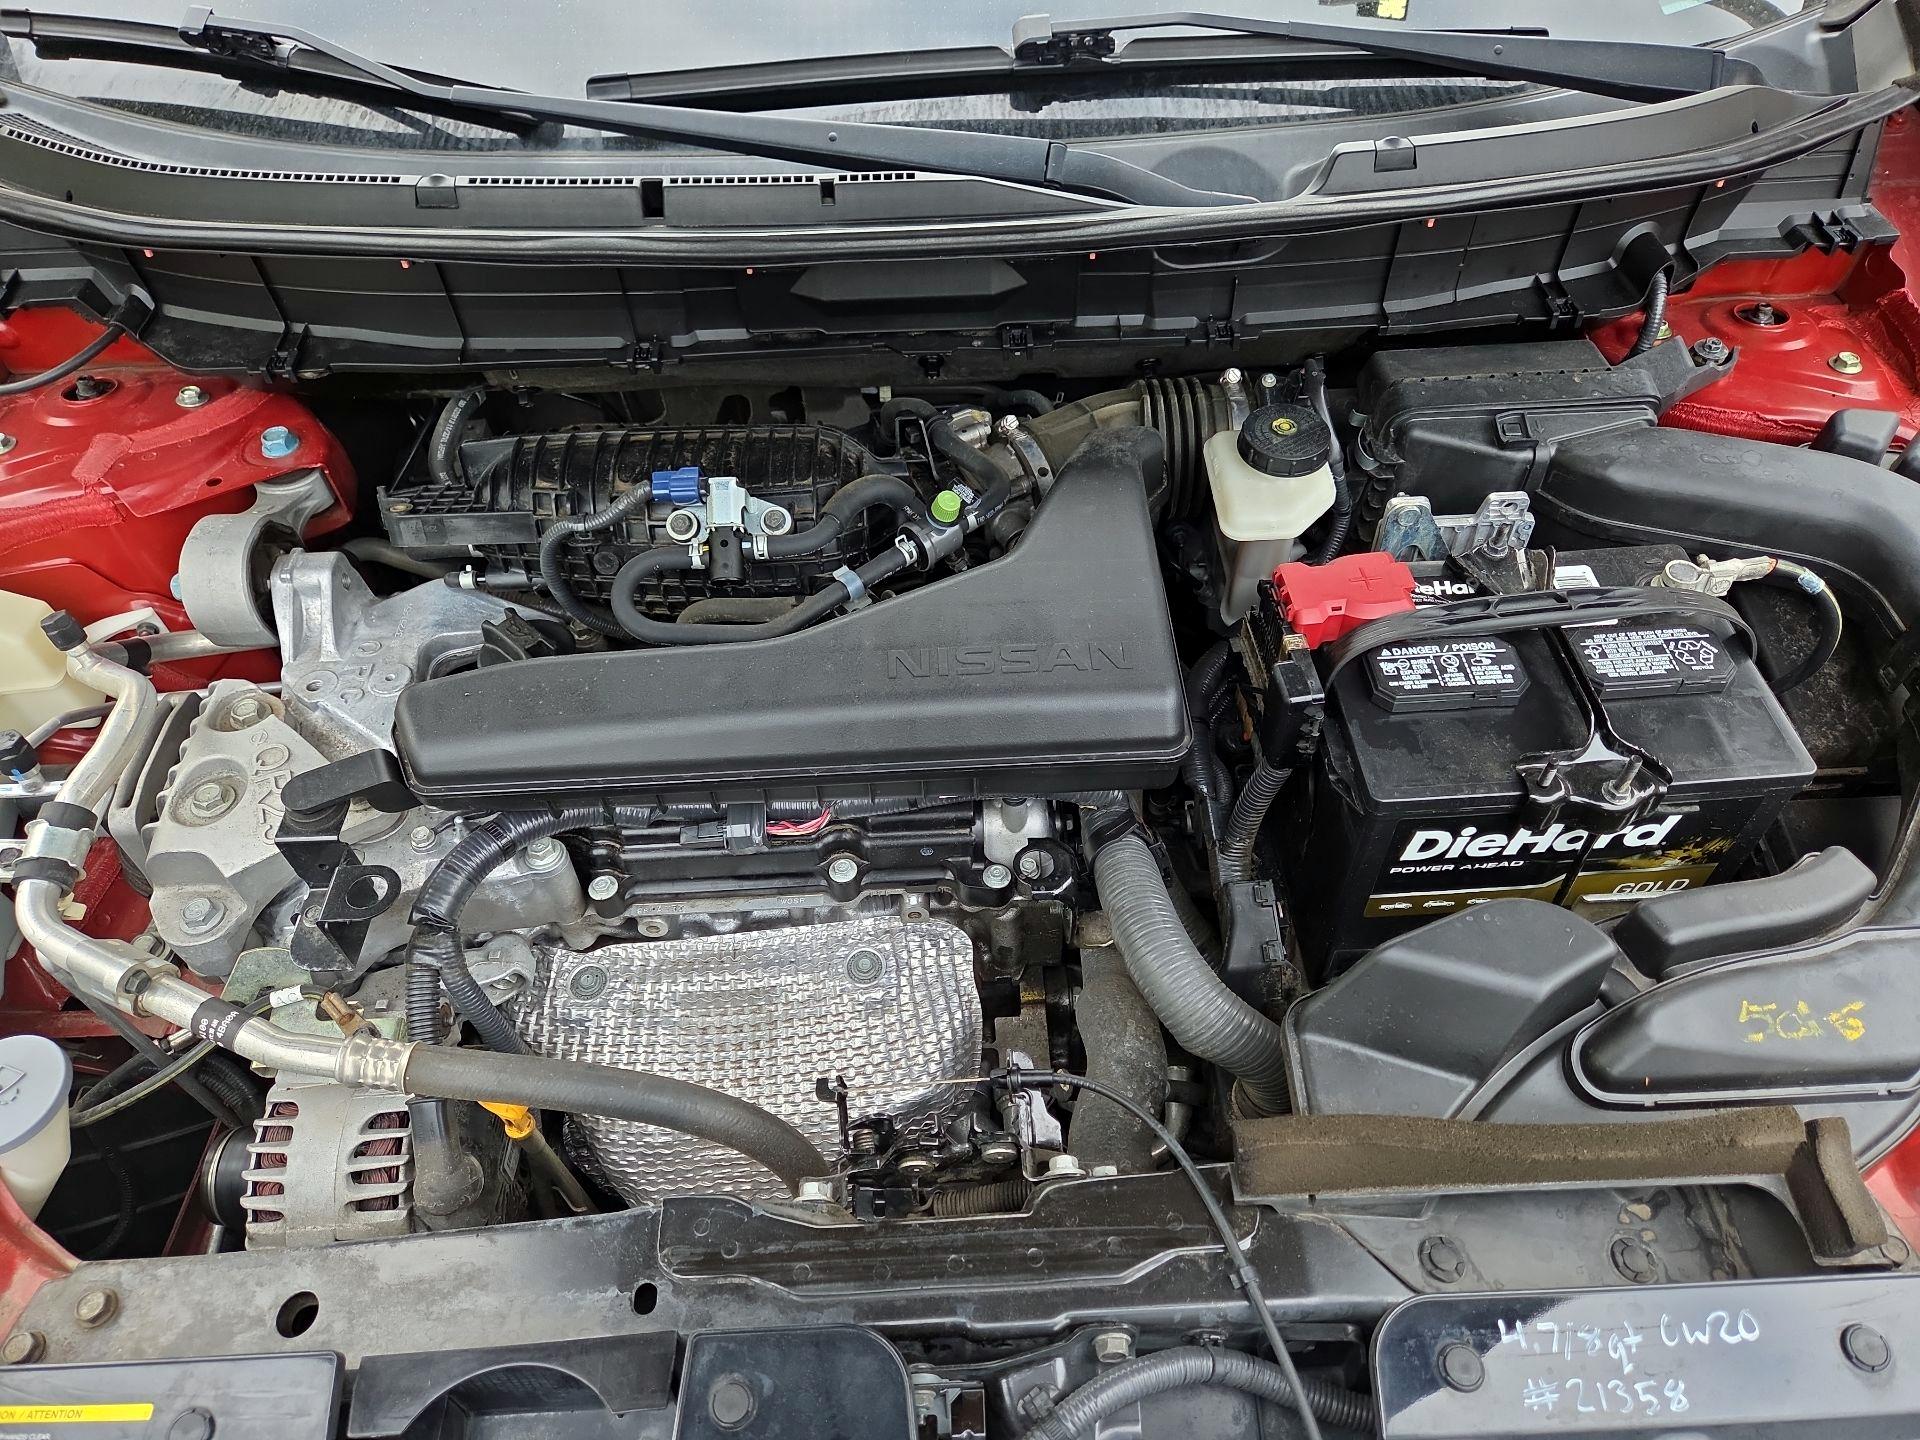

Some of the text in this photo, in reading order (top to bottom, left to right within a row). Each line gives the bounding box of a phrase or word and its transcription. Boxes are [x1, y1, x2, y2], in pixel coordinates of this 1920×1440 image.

[1414, 580, 1476, 595] eHa
[1391, 645, 1440, 656] DANGER
[1451, 641, 1496, 652] POISON
[887, 641, 1133, 680] NISSAN
[1400, 814, 1682, 861] DieHard
[1390, 859, 1526, 875] POWER AHEAD
[1611, 878, 1690, 895] GOLD
[1522, 1378, 1690, 1416] #21358
[0, 1410, 16, 1420] ON
[26, 1409, 83, 1420] ATTENTION
